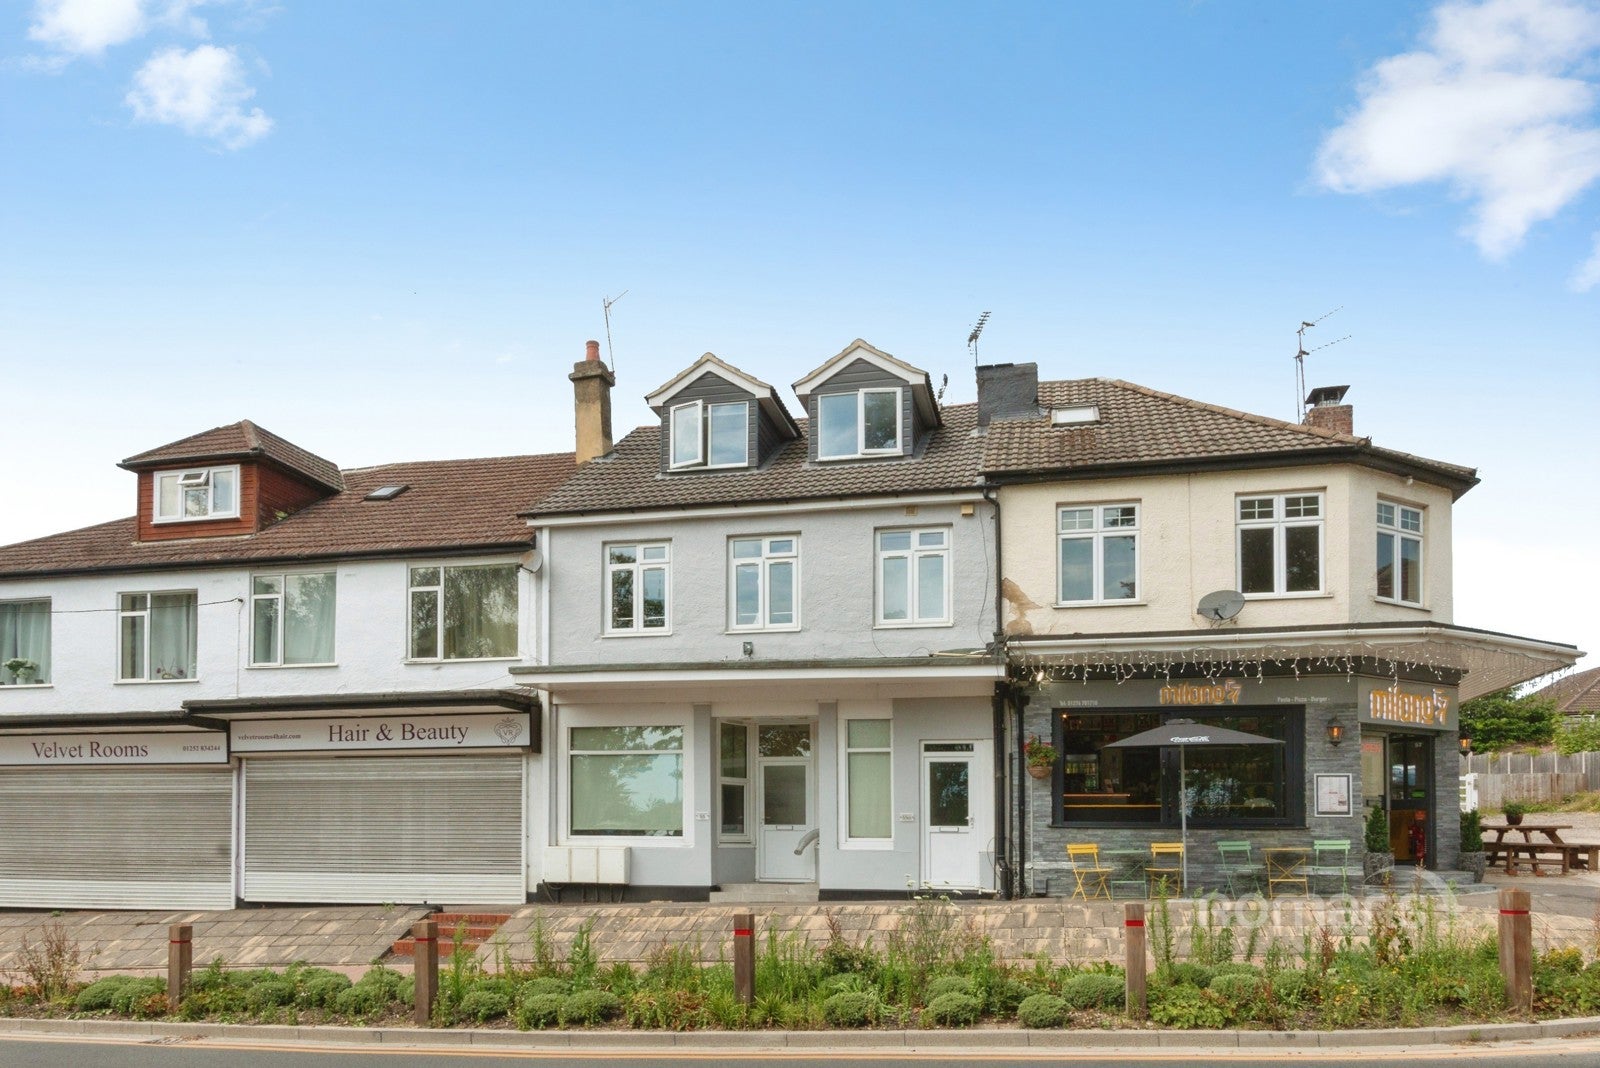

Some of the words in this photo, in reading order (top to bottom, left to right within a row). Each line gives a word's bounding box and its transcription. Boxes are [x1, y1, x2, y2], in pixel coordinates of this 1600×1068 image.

[328, 723, 370, 742] Hair
[376, 723, 394, 741] &
[401, 722, 469, 744] Beauty
[32, 741, 83, 758] Velvet
[89, 741, 149, 758] Rooms
